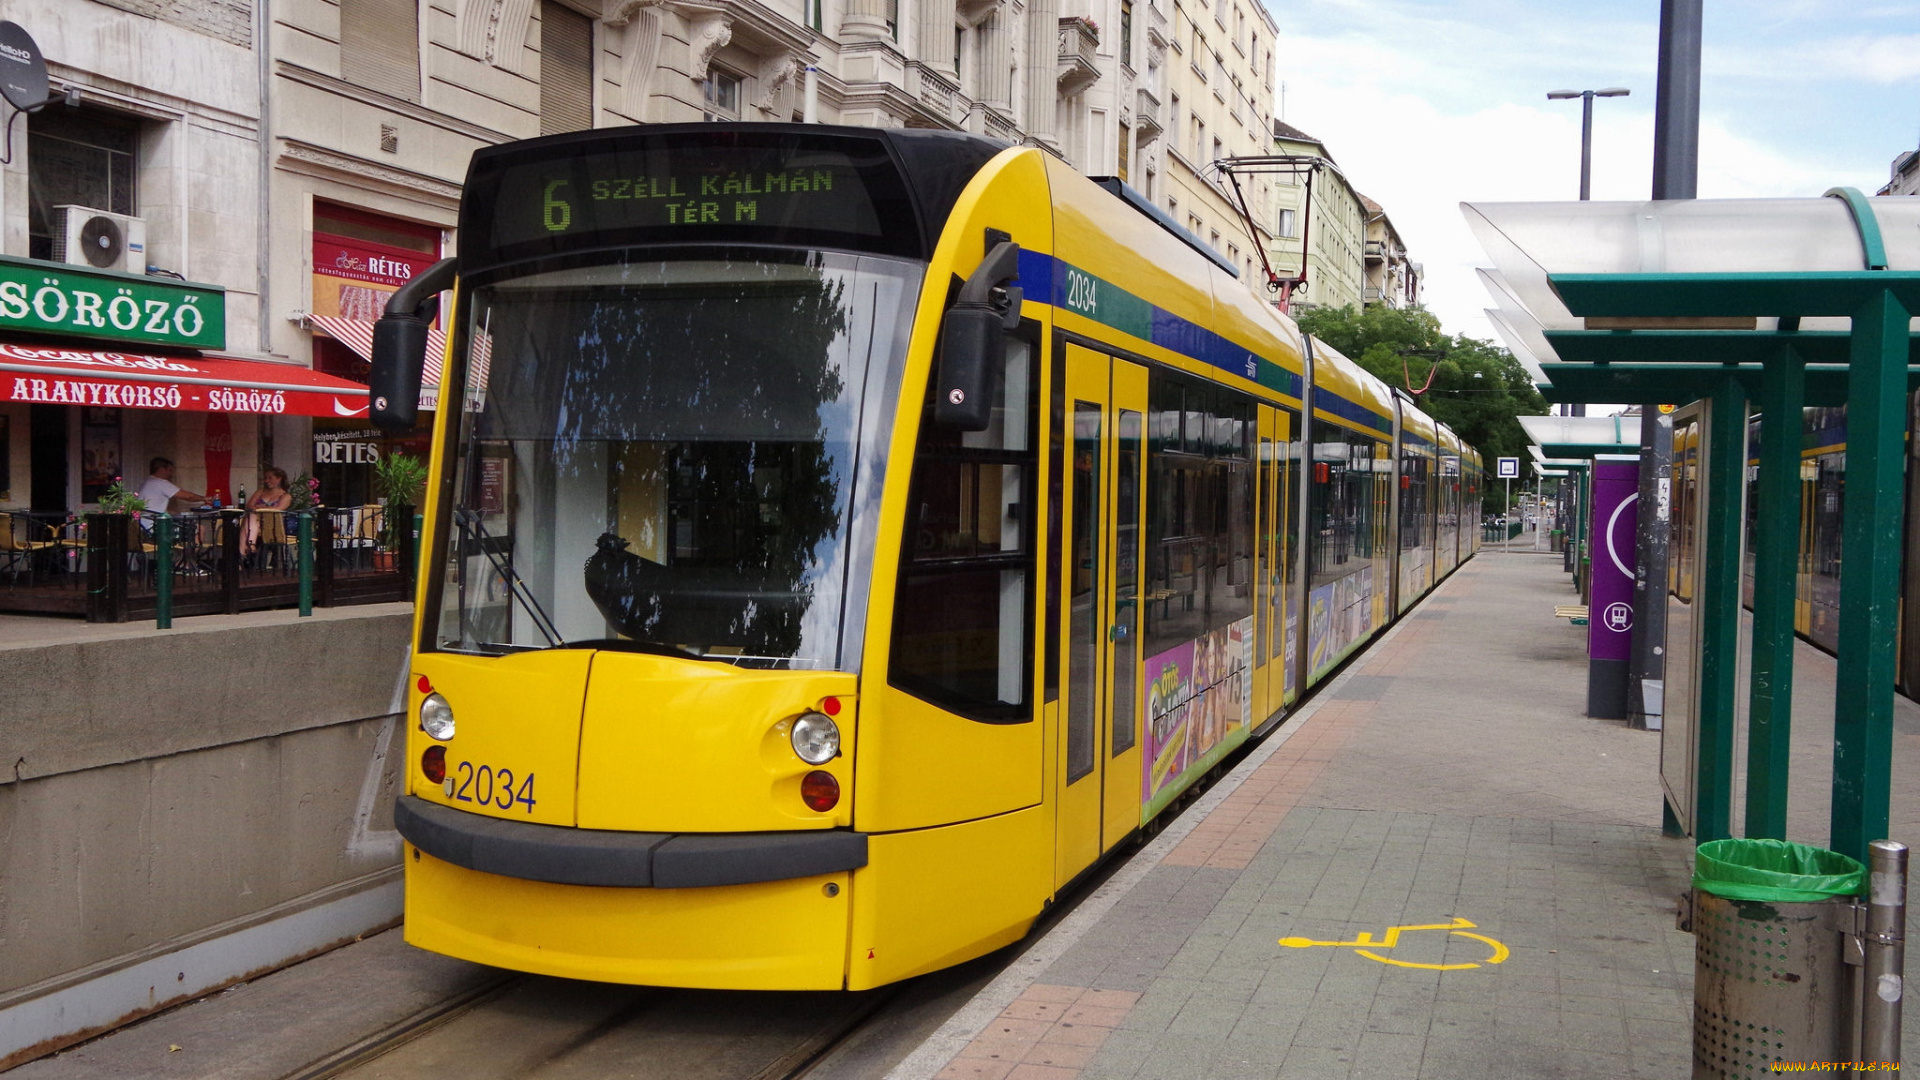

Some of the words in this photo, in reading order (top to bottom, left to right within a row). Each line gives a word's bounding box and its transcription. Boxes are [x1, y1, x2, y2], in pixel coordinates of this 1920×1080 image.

[543, 179, 571, 231] 6
[592, 176, 686, 199] SZÉLL
[701, 169, 832, 195] KÁLMÁN
[665, 200, 719, 224] TÉR
[735, 200, 757, 222] M
[368, 255, 411, 280] RÉTES
[0, 277, 205, 338] SÖRÖZŐ
[1067, 269, 1097, 315] 2034
[0, 343, 199, 373] Coca-Cola
[10, 378, 182, 408] ARANYKORSÓ
[208, 387, 286, 414] SÖRÖZŐ
[313, 433, 336, 443] Helyben
[456, 760, 537, 814] 2034
